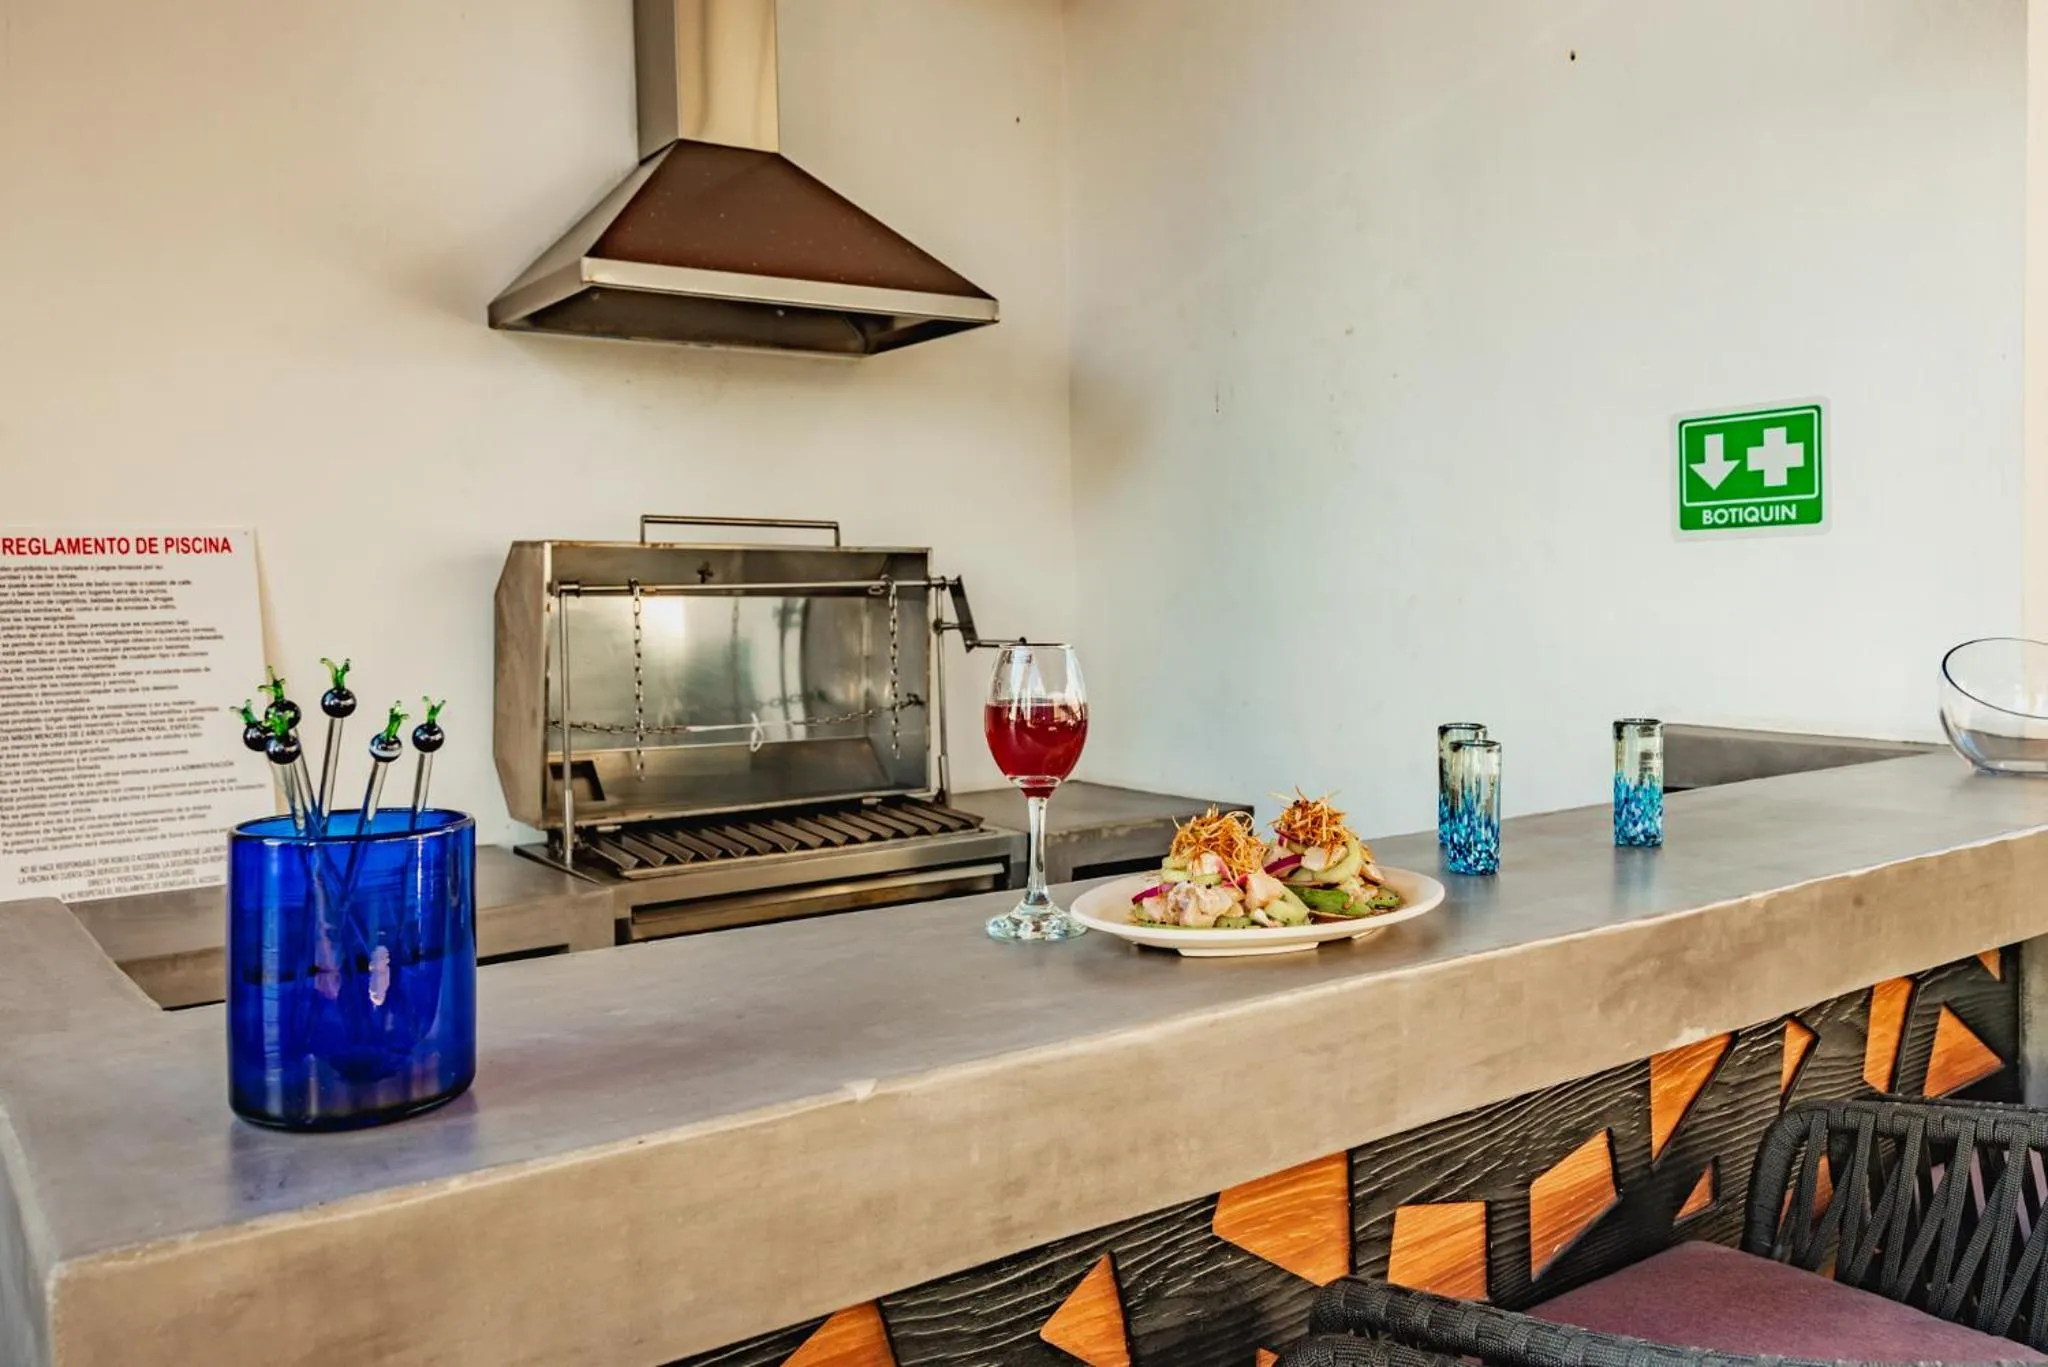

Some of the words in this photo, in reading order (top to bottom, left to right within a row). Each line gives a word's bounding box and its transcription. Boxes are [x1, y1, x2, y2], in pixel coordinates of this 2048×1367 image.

[1702, 504, 1797, 525] BOTIQUIN
[2, 537, 130, 555] REGLAMENTO
[136, 537, 158, 554] DE
[165, 536, 232, 554] PISCINA
